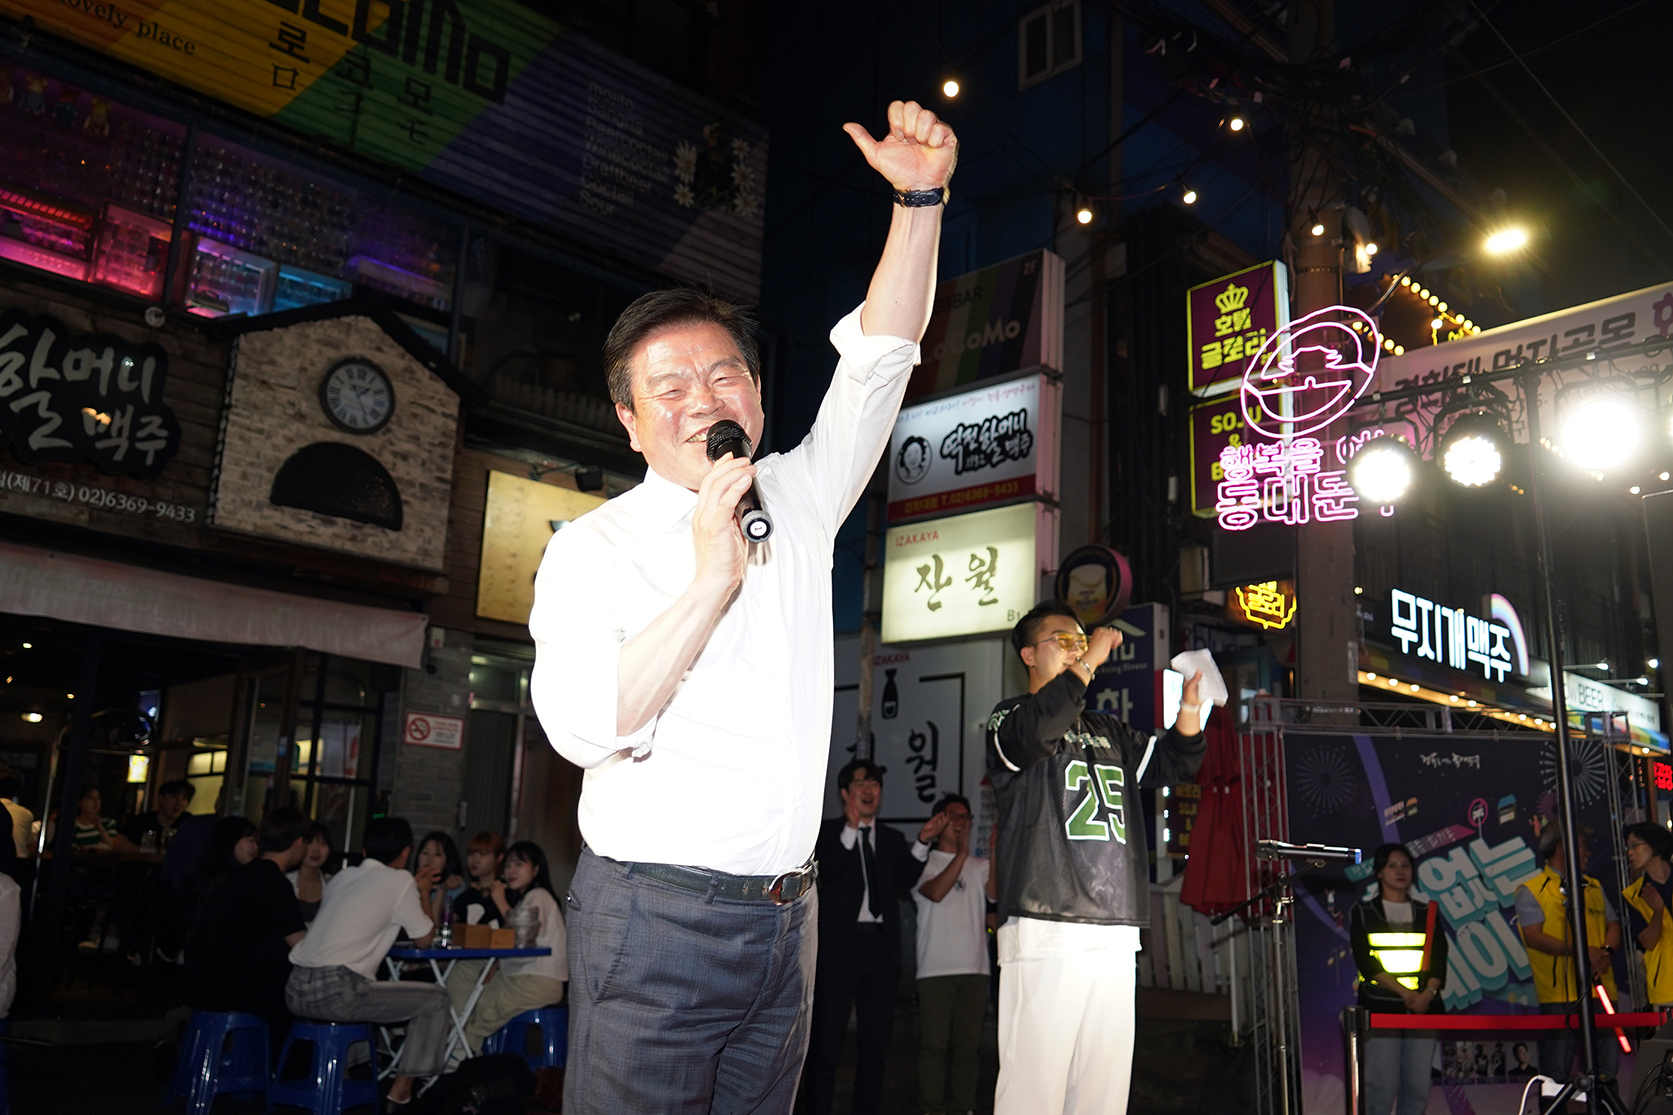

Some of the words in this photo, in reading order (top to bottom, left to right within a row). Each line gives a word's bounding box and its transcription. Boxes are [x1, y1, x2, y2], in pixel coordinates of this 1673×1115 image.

[60, 0, 129, 28] ovely
[137, 21, 197, 56] place
[579, 189, 615, 216] Sour
[1023, 259, 1037, 276] 2F
[921, 317, 1021, 365] oCoMo
[1201, 327, 1267, 370] 글로리
[82, 404, 169, 467] 맥주
[1219, 437, 1324, 481] 행복을
[79, 486, 196, 524] 02)6369-9433
[895, 530, 940, 547] IZAKAYA
[1391, 588, 1512, 683] 무지개맥주
[1064, 759, 1127, 845] 25
